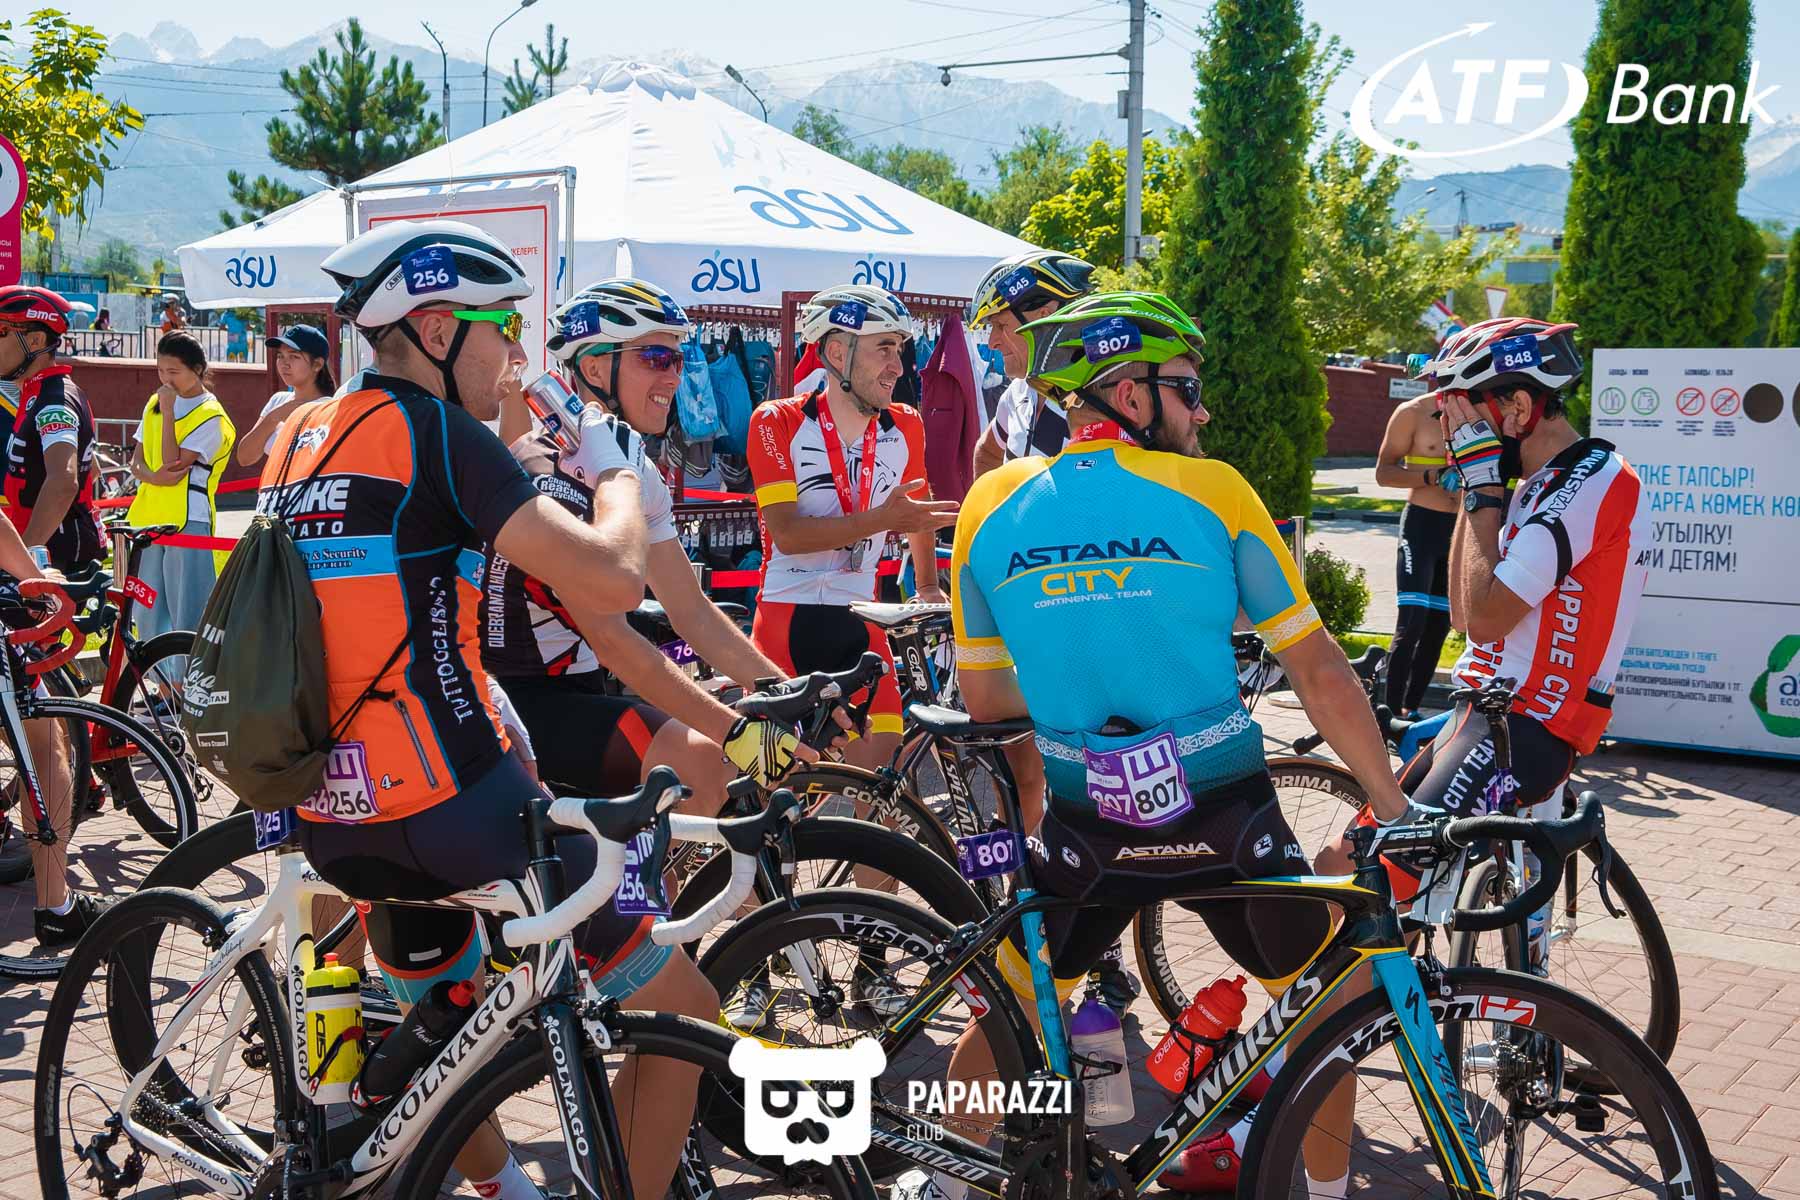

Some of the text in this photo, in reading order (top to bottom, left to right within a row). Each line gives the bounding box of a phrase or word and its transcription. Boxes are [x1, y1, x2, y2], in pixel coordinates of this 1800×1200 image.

[412, 268, 450, 289] 256
[1008, 277, 1030, 296] 845
[570, 320, 589, 337] 251
[836, 311, 856, 325] 766
[1097, 335, 1131, 355] 807
[1503, 351, 1533, 368] 848
[1677, 465, 1755, 488] ТАПСЫР!
[1647, 491, 1695, 513] АРҒА
[1701, 494, 1766, 517] КӨМЕК
[322, 546, 368, 560] Security
[1006, 536, 1184, 578] ASTANA
[1668, 549, 1738, 573] ДЕТЯМ!
[125, 581, 146, 598] 365
[1041, 566, 1134, 596] CITY
[1033, 588, 1152, 609] CONTINENTAL TEAM
[674, 644, 694, 660] 76
[1525, 575, 1584, 722] APPLE CITY
[1443, 767, 1473, 809] CITY
[1463, 738, 1496, 771] TEA
[329, 790, 372, 815] 256
[1134, 775, 1179, 814] 807
[1334, 790, 1362, 810] AERO
[977, 839, 1014, 867] 807
[1115, 842, 1217, 860] ASTANA
[617, 872, 645, 901] 256
[292, 977, 310, 1082] COLNAGO
[382, 979, 515, 1147] COLNAGO
[1152, 972, 1324, 1157] S-WORKS
[548, 1029, 590, 1156] COLNAGO
[871, 1128, 990, 1181] PECIALIZED
[176, 1154, 228, 1186] COLNAGO
